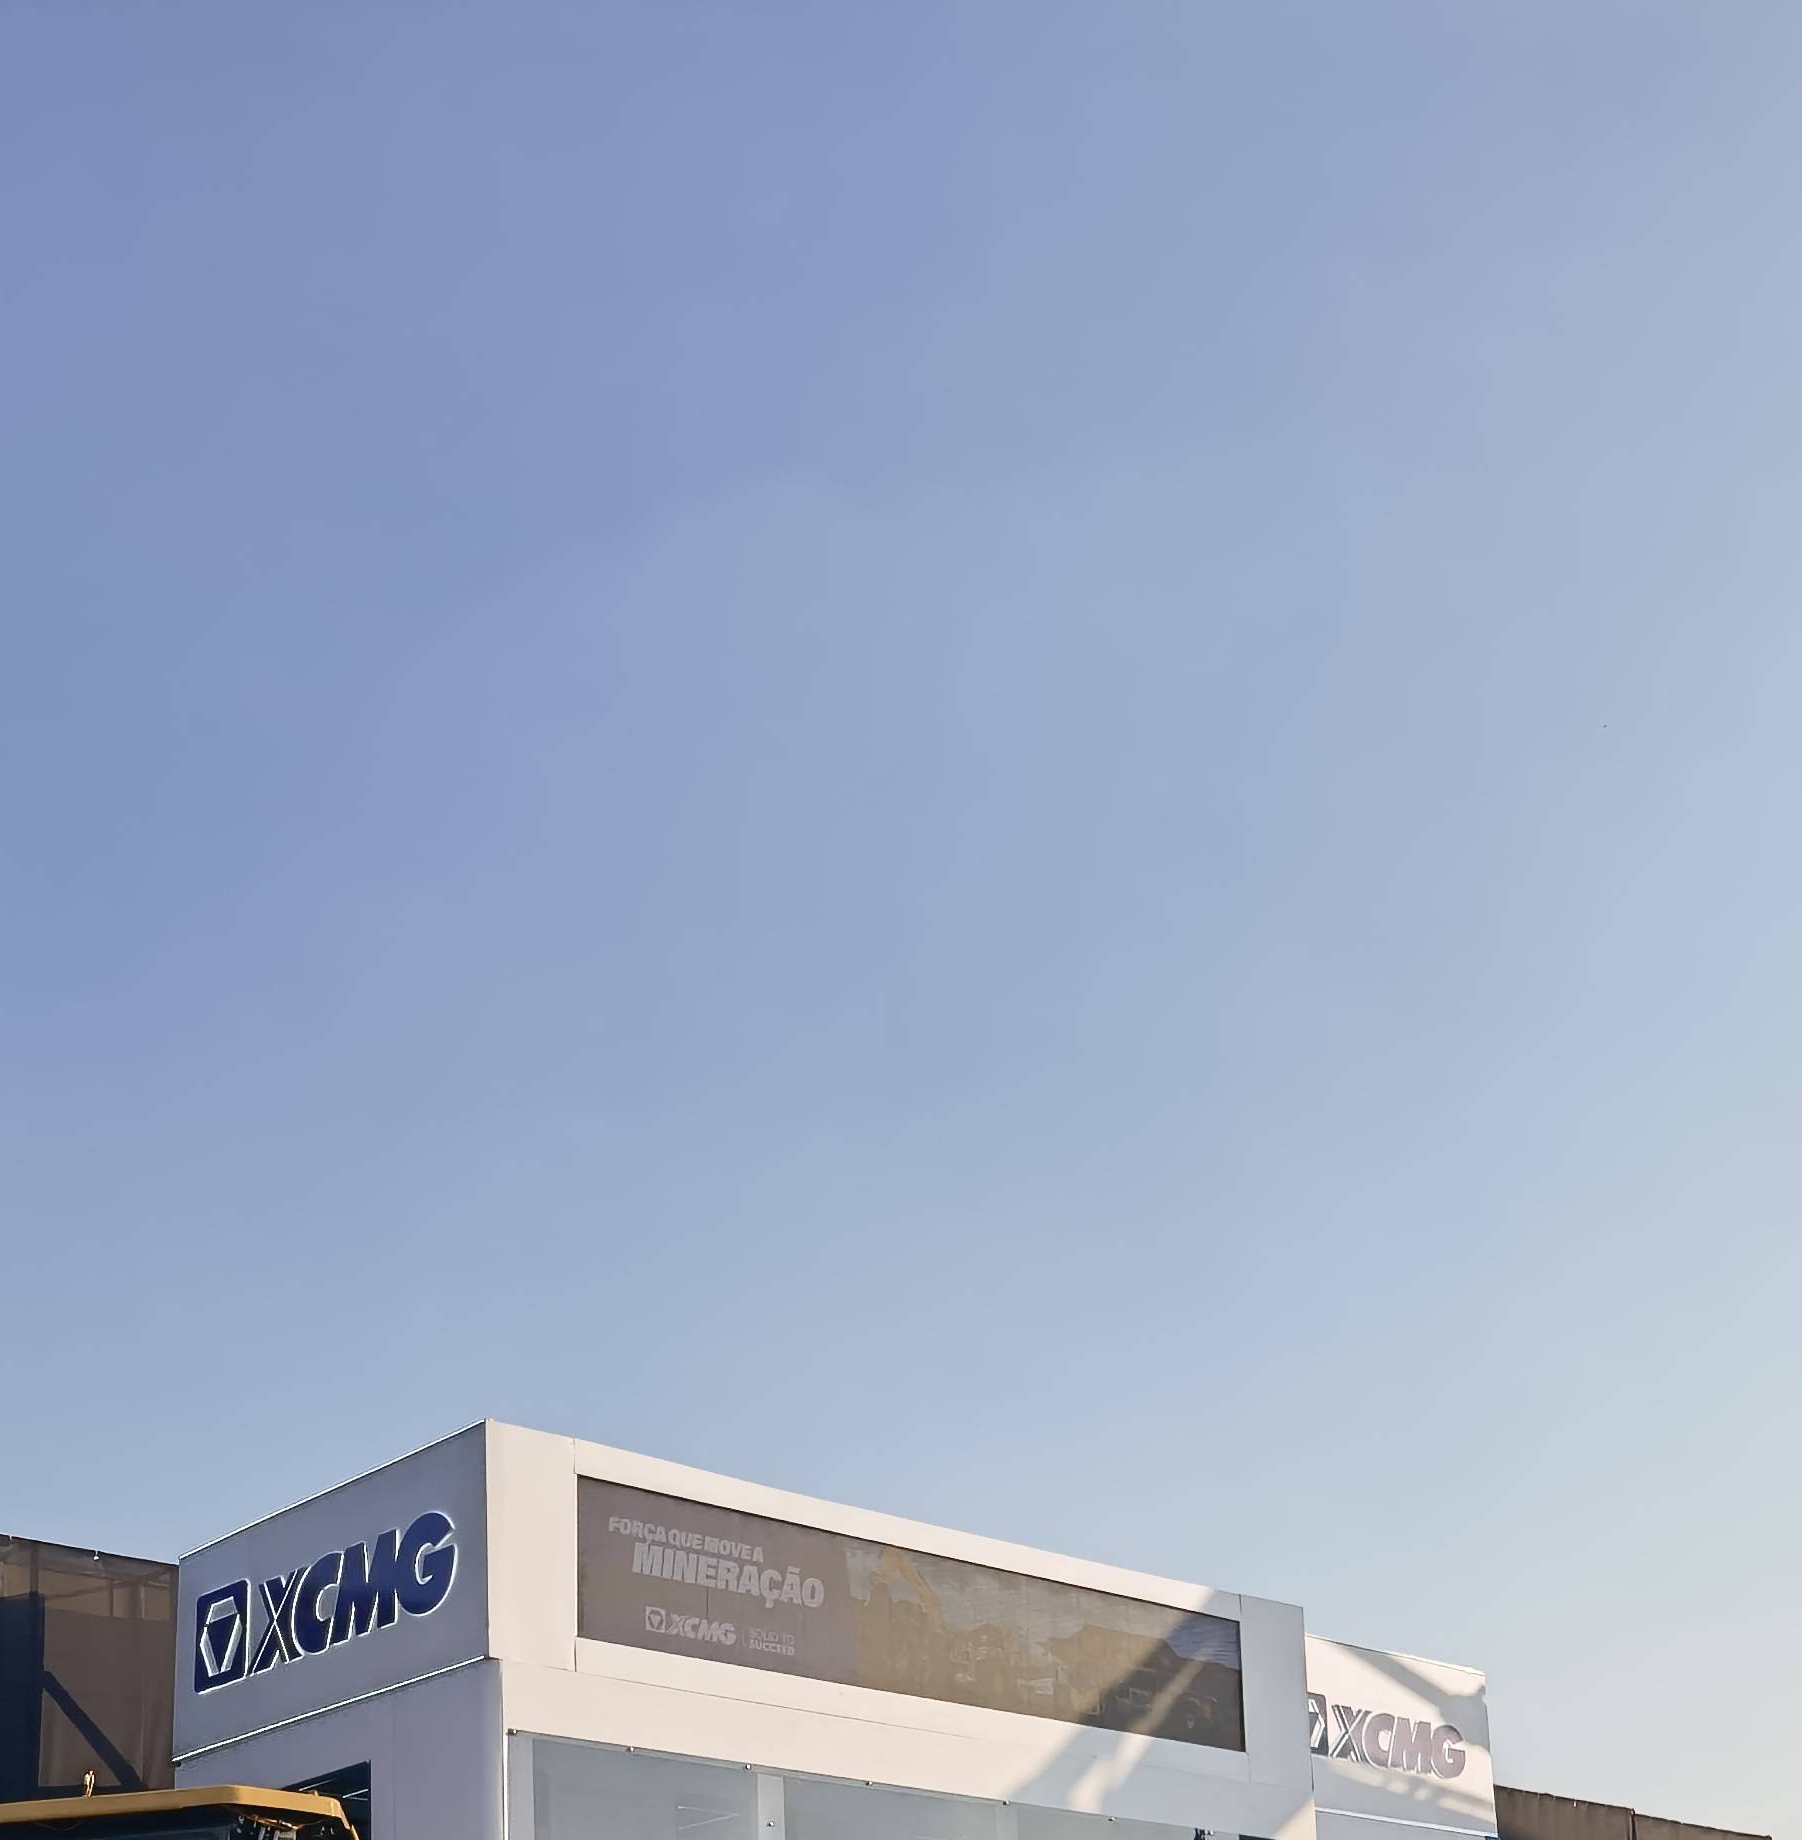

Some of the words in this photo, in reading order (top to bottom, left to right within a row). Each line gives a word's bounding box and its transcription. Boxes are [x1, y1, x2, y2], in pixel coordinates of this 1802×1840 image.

[608, 1516, 667, 1544] FORÇA
[668, 1528, 703, 1550] QUE
[704, 1536, 752, 1561] MOVE
[752, 1546, 764, 1563] A
[251, 1510, 458, 1677] XCMG
[632, 1541, 825, 1609] MINERAÇÃO
[667, 1612, 737, 1646] XCMG
[1329, 1703, 1466, 1779] XCMG
